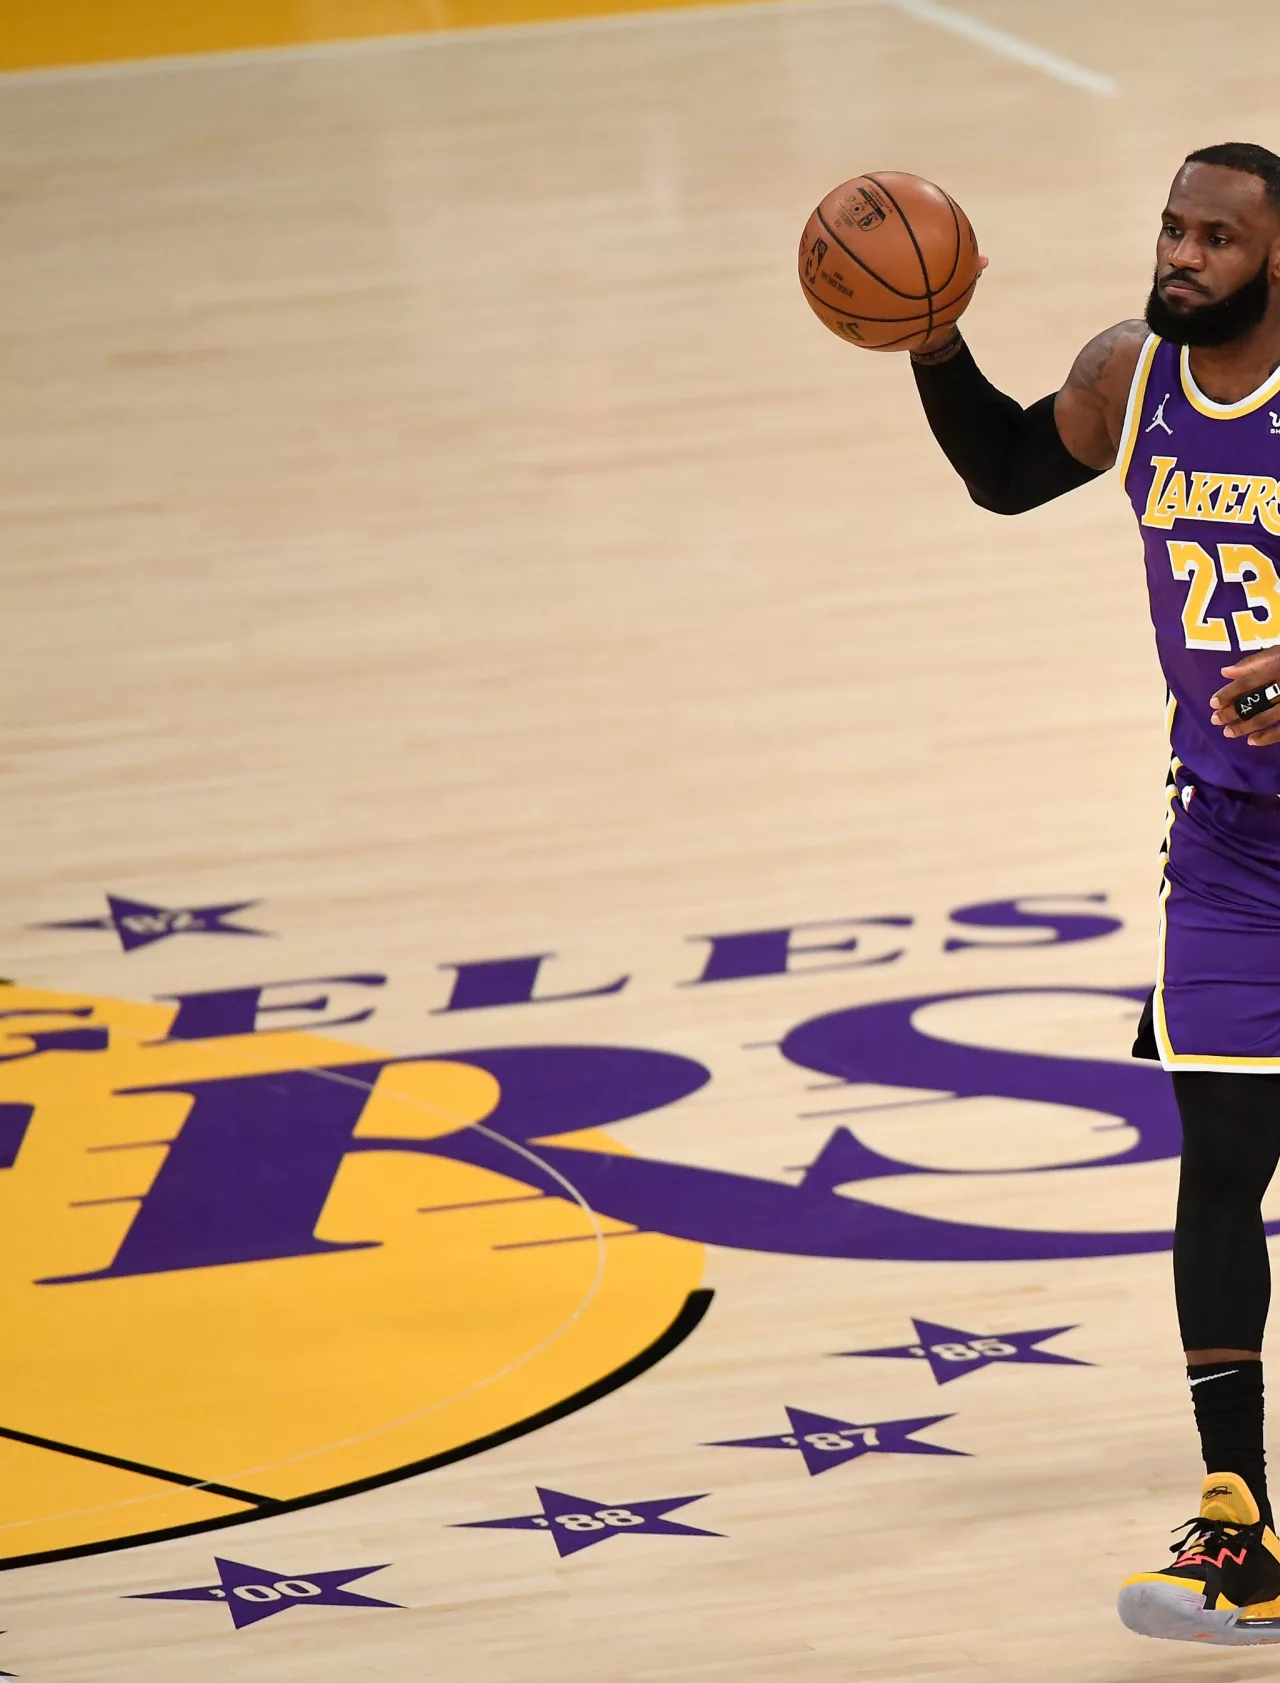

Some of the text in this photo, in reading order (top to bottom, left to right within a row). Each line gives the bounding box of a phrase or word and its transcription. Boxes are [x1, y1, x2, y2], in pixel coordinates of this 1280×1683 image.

[908, 1338, 1018, 1361] '85
[780, 1427, 880, 1451] '87
[531, 1508, 645, 1531] '88
[208, 1580, 322, 1602] '00
